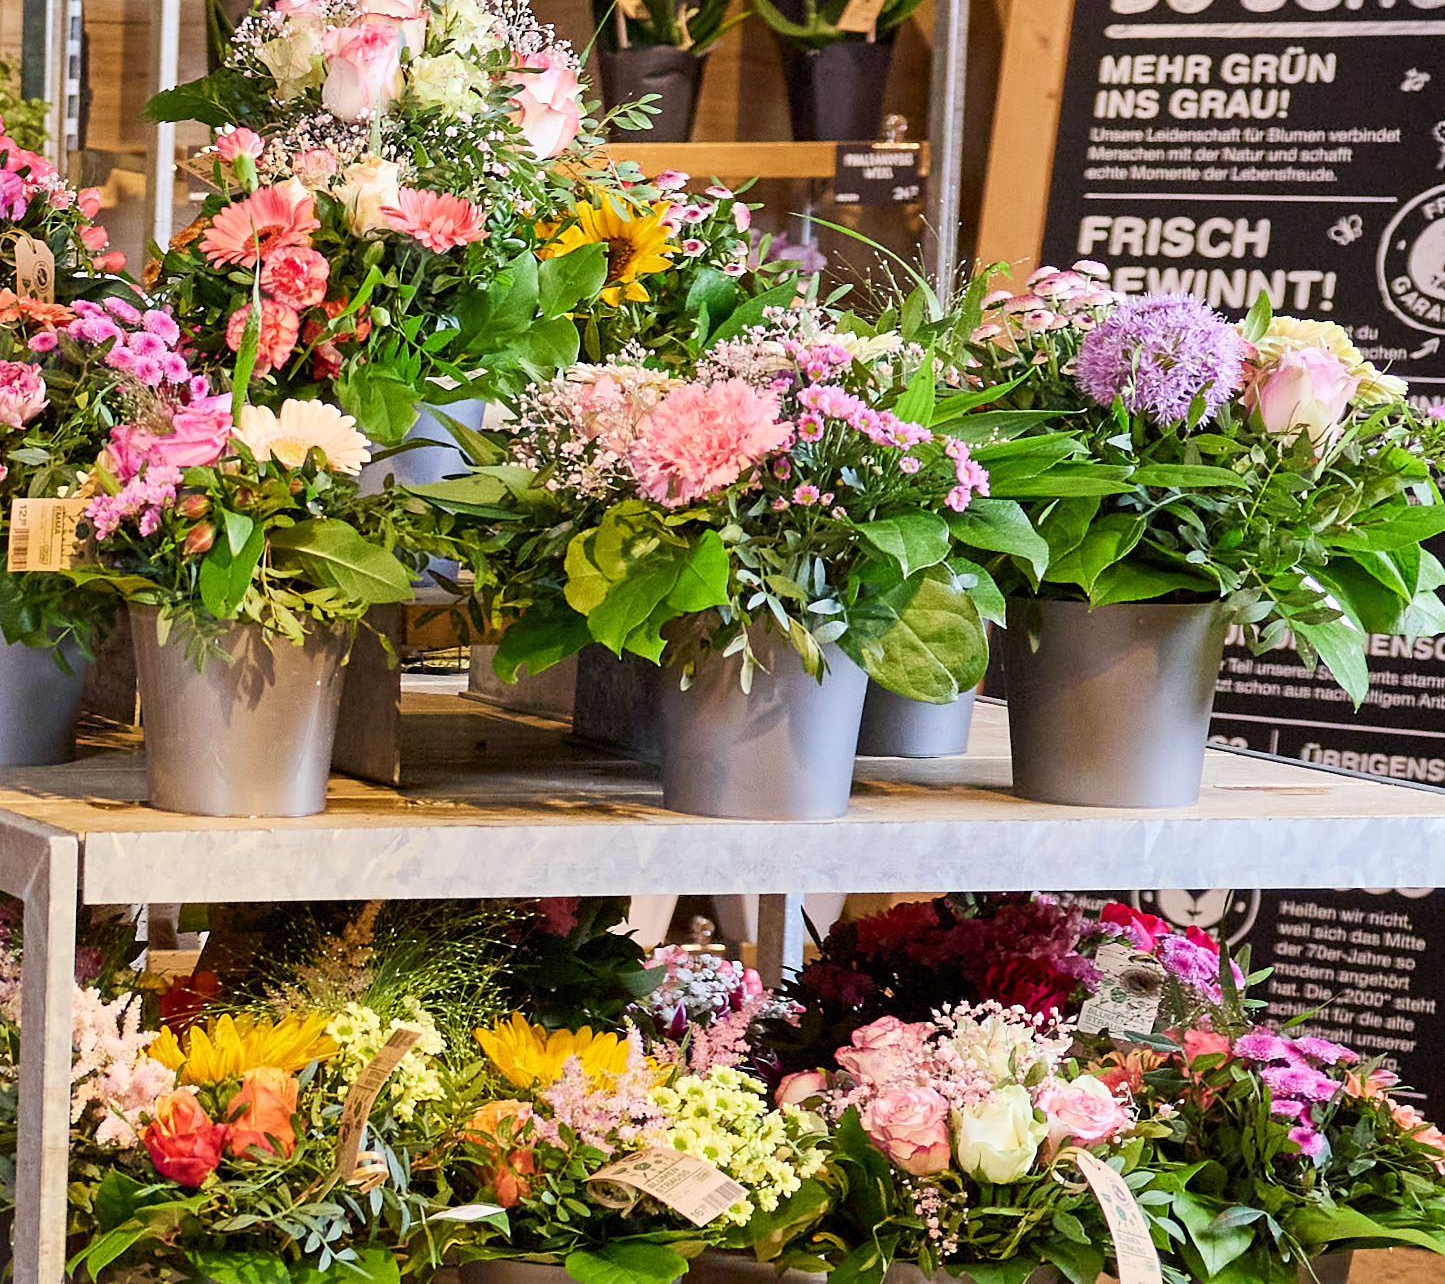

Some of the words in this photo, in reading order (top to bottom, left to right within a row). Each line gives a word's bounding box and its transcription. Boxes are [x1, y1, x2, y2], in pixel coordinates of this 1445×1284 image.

[1099, 54, 1212, 84] MEHR
[1220, 46, 1337, 84] GRÜN
[1094, 88, 1160, 119] INS
[1169, 87, 1291, 119] GRAU!
[1090, 128, 1144, 143] Unsere
[1146, 128, 1240, 143] Leidenschaft
[1243, 128, 1265, 143] für
[1266, 128, 1325, 143] Blumen
[1328, 128, 1401, 143] verbindet
[1087, 146, 1165, 161] Menschen
[1169, 146, 1192, 161] mit
[1194, 147, 1220, 161] der
[1223, 147, 1265, 162] Natur
[1269, 147, 1298, 162] und
[1299, 147, 1353, 163] schafft
[1084, 166, 1129, 180] echte
[1131, 166, 1202, 181] Momente
[1204, 166, 1228, 181] der
[1077, 215, 1271, 259] FRISCH
[1104, 267, 1337, 313] EWINNT!
[1227, 658, 1254, 675] Teil
[1234, 680, 1281, 695] schon
[1283, 685, 1311, 699] aus
[1279, 900, 1337, 920] Heißen
[1339, 908, 1366, 923] wir
[1366, 911, 1413, 931] nicht,
[1276, 923, 1311, 937] weil
[1312, 926, 1347, 941] sich
[1348, 930, 1381, 946] das
[1383, 932, 1426, 952] Mitte
[1272, 941, 1304, 956] der
[1304, 943, 1392, 968] 70er-Jahre
[1393, 957, 1416, 971] so
[1272, 963, 1335, 981] modern
[1335, 970, 1411, 991] angehört
[1268, 979, 1300, 997] hat.
[1303, 984, 1333, 1001] Die
[1392, 997, 1436, 1015] steht
[1330, 1007, 1356, 1024] für
[1356, 1012, 1383, 1028] die
[1384, 1015, 1416, 1033] alte
[1354, 1033, 1417, 1053] unserer
